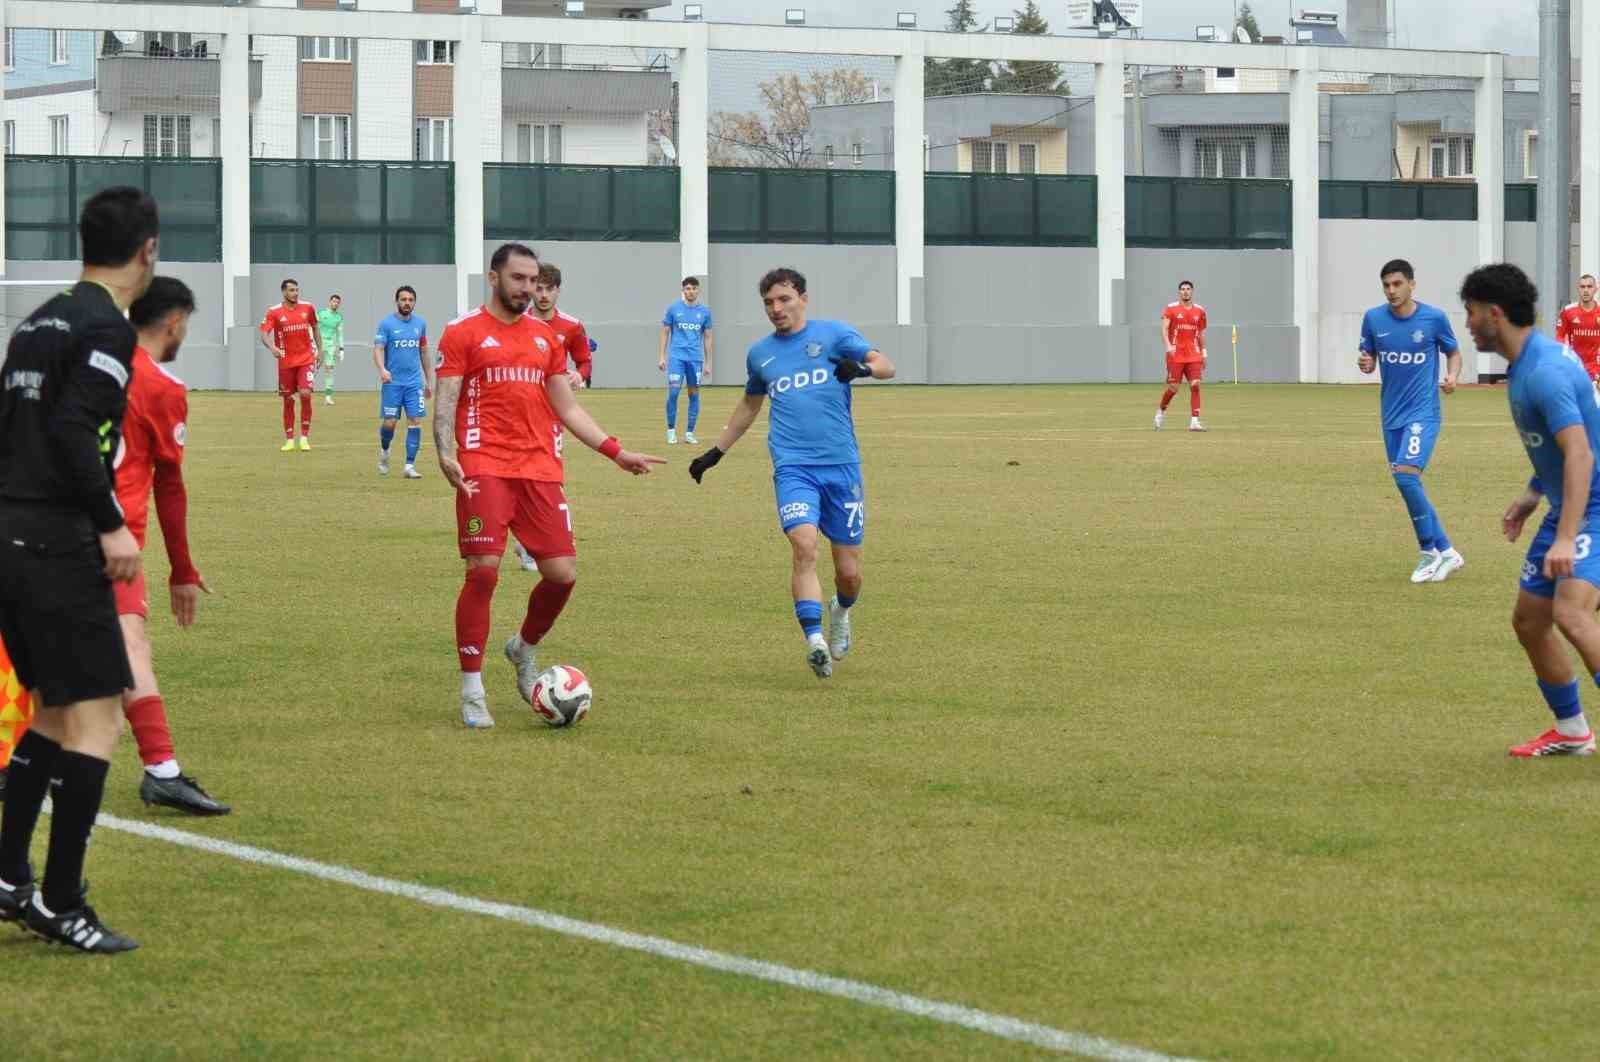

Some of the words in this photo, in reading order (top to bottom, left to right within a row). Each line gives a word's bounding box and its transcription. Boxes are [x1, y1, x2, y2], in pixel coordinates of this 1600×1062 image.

[1379, 351, 1426, 364] TCDD
[1407, 435, 1421, 455] 8
[1574, 533, 1592, 560] 3
